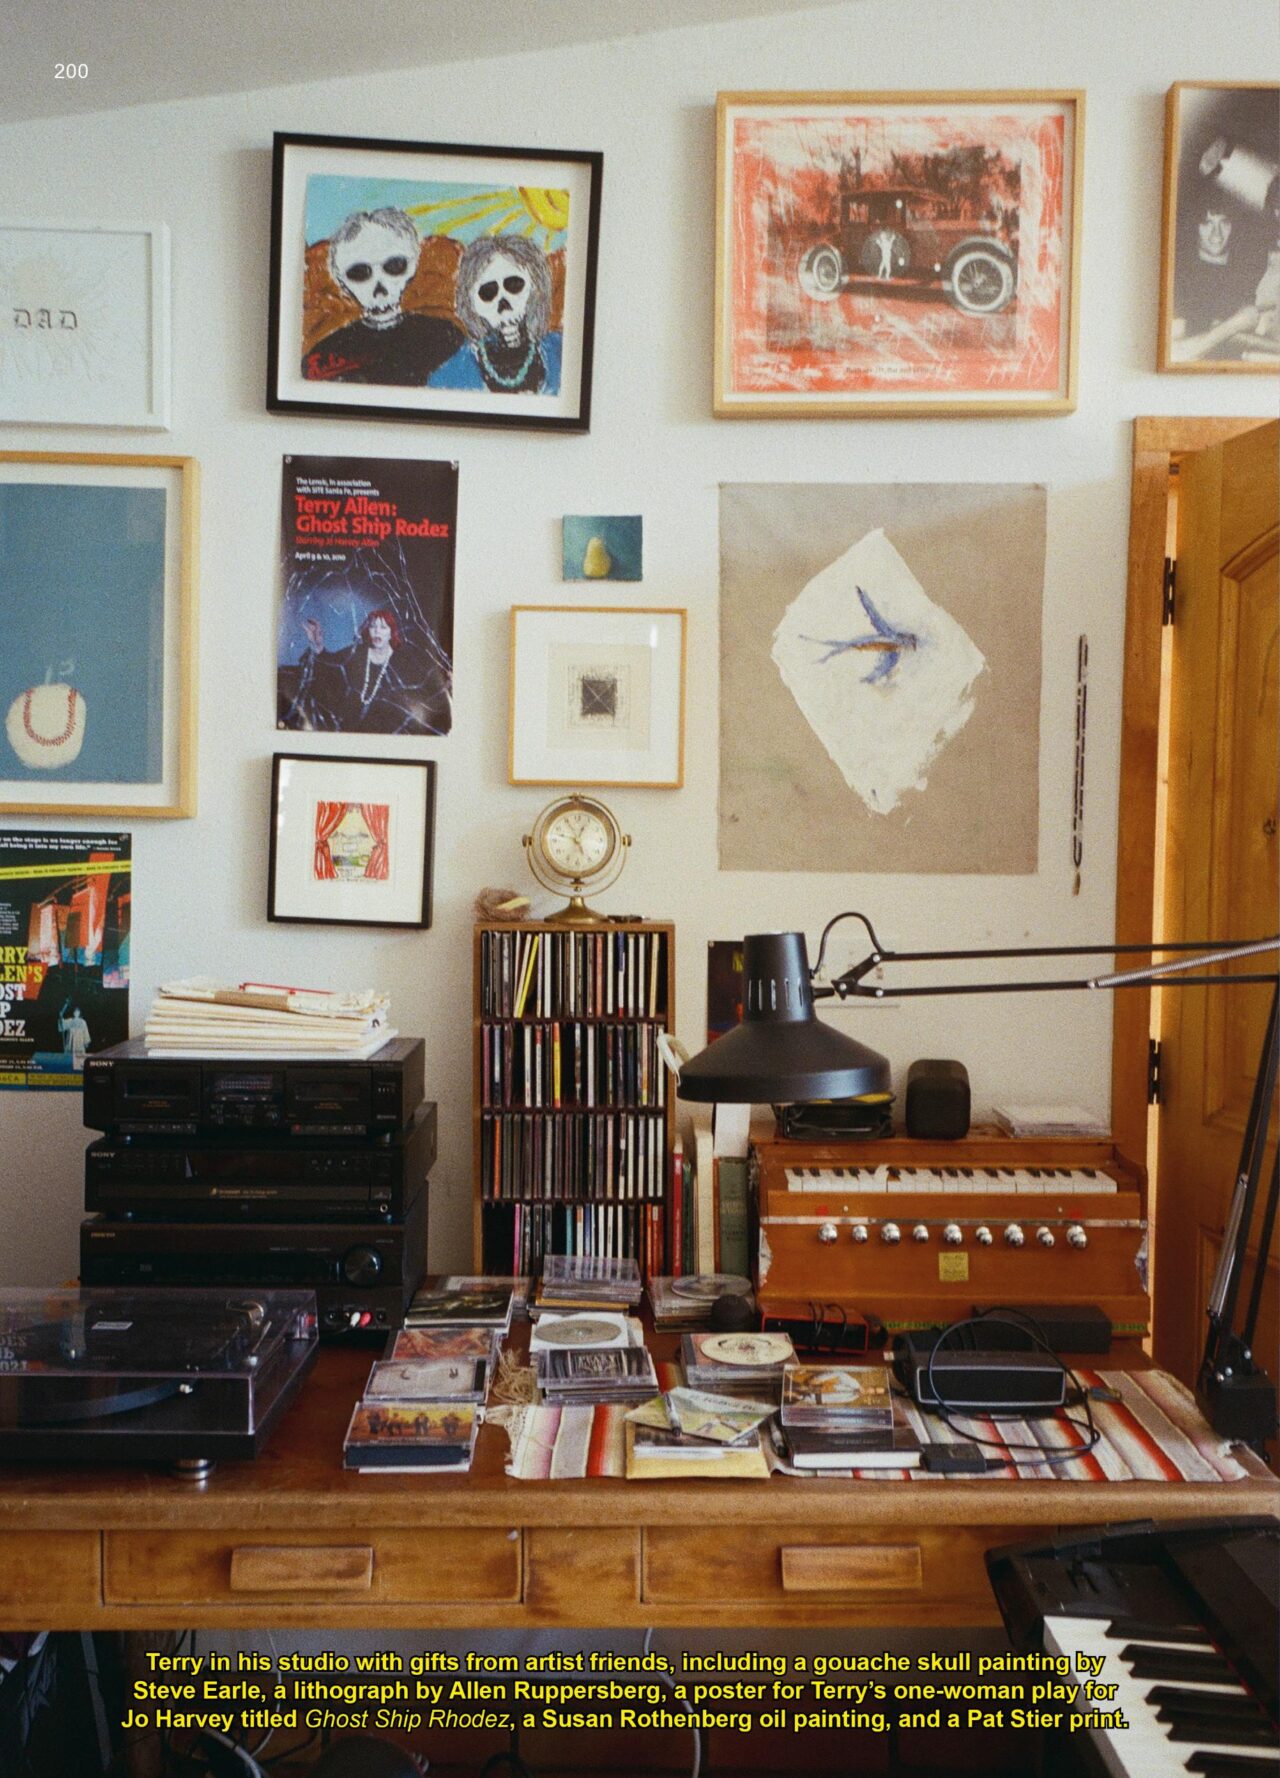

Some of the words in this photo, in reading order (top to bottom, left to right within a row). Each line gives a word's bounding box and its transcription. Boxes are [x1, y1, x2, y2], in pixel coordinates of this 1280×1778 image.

[13, 308, 78, 330] DAD
[325, 487, 343, 495] Santa
[295, 495, 342, 519] Terry
[344, 496, 398, 516] Allen:
[296, 515, 349, 534] Ghost
[352, 517, 392, 540] Ship
[395, 518, 449, 538] Rodez
[295, 552, 311, 561] April
